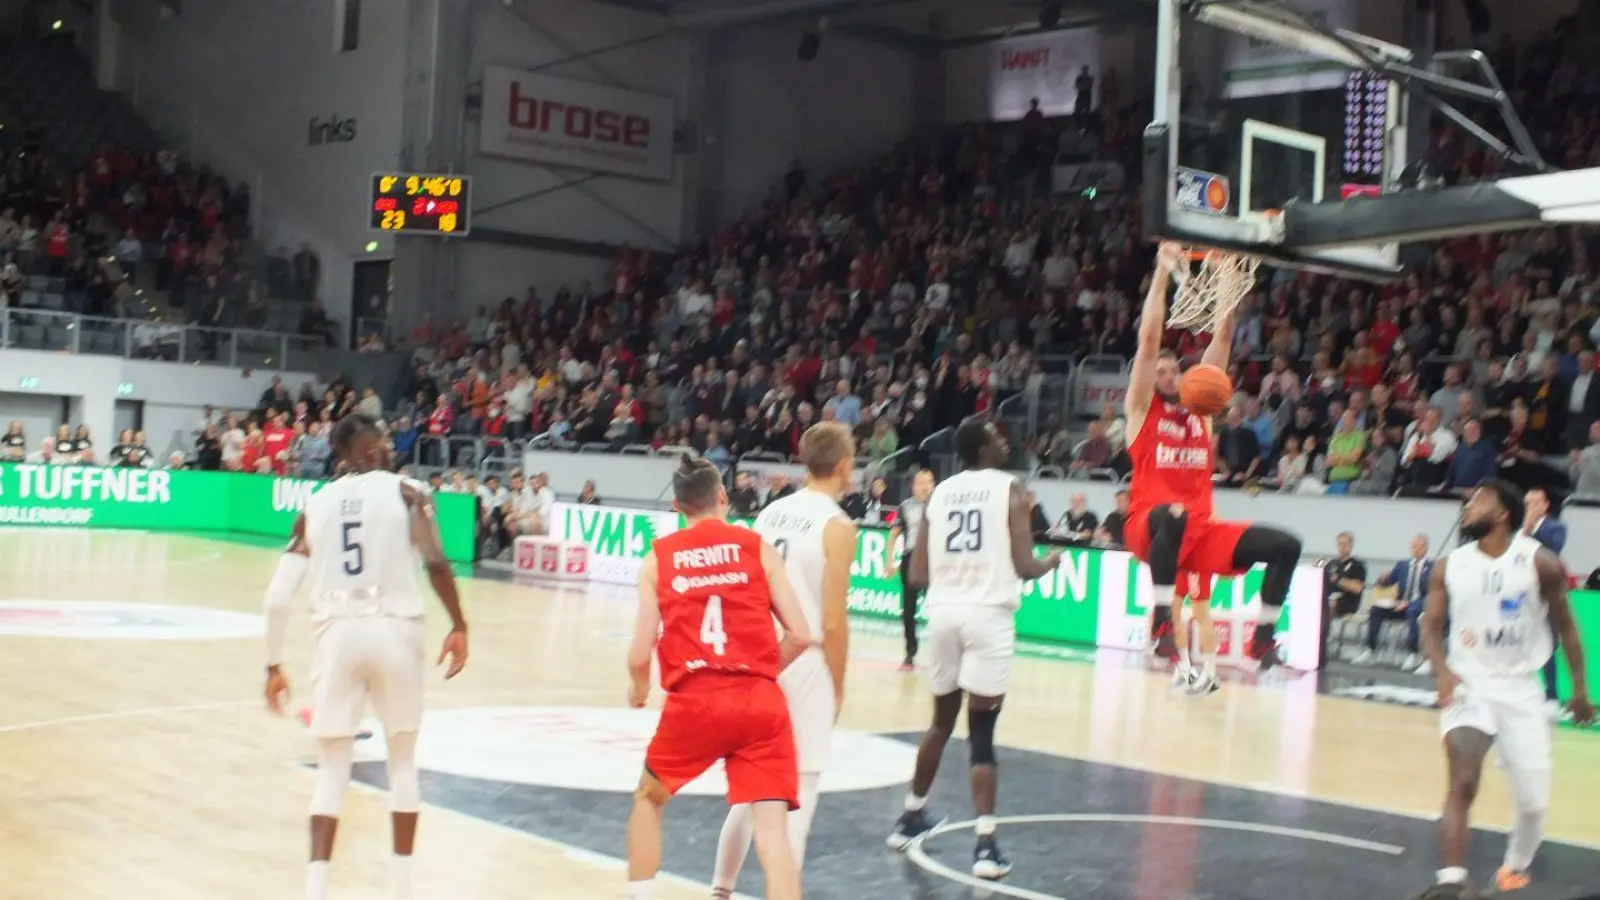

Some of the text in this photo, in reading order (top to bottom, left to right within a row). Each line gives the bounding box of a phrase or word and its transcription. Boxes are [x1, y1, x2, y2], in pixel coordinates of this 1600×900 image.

[307, 112, 357, 147] links
[508, 81, 652, 148] brose
[341, 521, 363, 576] 5
[945, 509, 983, 553] 29
[673, 543, 741, 570] PREWITT
[700, 595, 728, 656] 4
